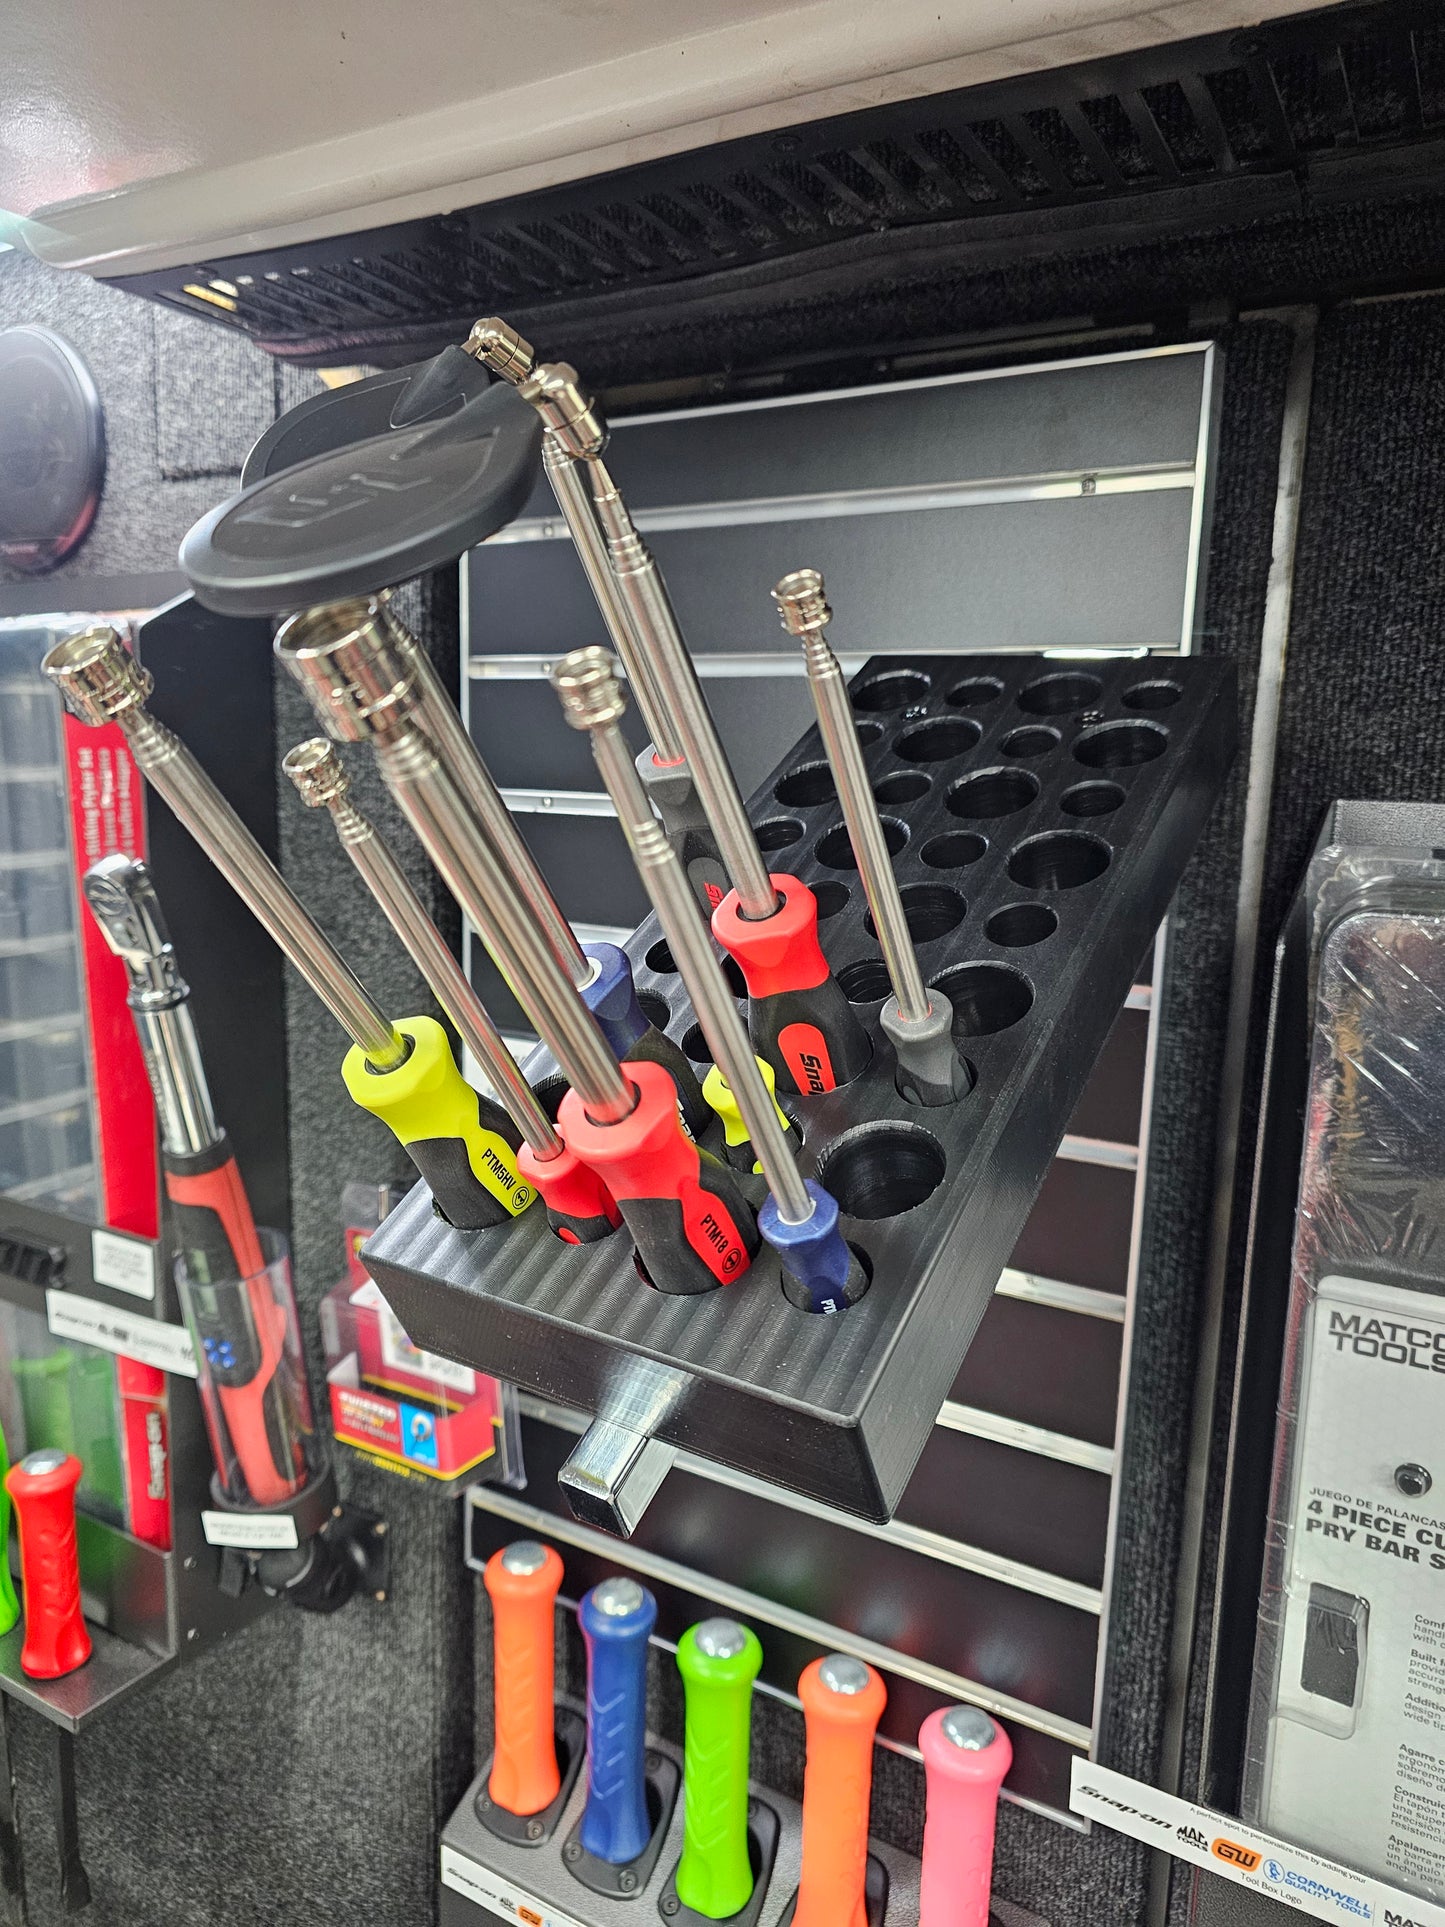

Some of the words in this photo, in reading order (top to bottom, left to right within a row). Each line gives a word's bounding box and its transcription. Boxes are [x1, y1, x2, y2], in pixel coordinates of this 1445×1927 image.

[799, 1052, 825, 1096] Sna
[481, 1147, 517, 1191] PTM5HV
[700, 1213, 729, 1254] PTM18
[1309, 1487, 1352, 1504] JUEGO
[1356, 1498, 1373, 1510] DE
[1307, 1499, 1323, 1514] 4
[1332, 1504, 1407, 1539] PIECE
[1306, 1518, 1357, 1543] PRY
[1365, 1534, 1420, 1563] BAR
[1412, 1633, 1437, 1646] with
[1411, 1648, 1437, 1665] Built
[1403, 1711, 1430, 1725] wide
[1404, 1702, 1441, 1720] design
[1399, 1743, 1436, 1763] Agarre
[1396, 1769, 1433, 1788] diseño
[1077, 1785, 1173, 1829] Snap-on
[1392, 1803, 1413, 1816] una
[1406, 1799, 1438, 1817] tapón
[1391, 1811, 1441, 1835] precisión
[1176, 1825, 1209, 1847] MAC
[1177, 1834, 1209, 1853] TOOLS
[1217, 1842, 1257, 1868] GW
[1386, 1851, 1401, 1862] un
[1403, 1858, 1441, 1878] ángulo
[1387, 1843, 1402, 1854] de
[1404, 1849, 1432, 1866] barra
[1321, 1861, 1348, 1878] adding
[1348, 1872, 1367, 1884] your
[1385, 1859, 1417, 1878] ancha
[1420, 1873, 1444, 1887] para
[1241, 1872, 1260, 1887] Tool
[1261, 1881, 1278, 1895] Box
[1280, 1890, 1303, 1905] Logo
[1284, 1878, 1331, 1901] QUALITY
[1335, 1899, 1372, 1919] TOOLS
[1286, 1870, 1372, 1914] CORNWELL
[1384, 1909, 1427, 1927] MA
